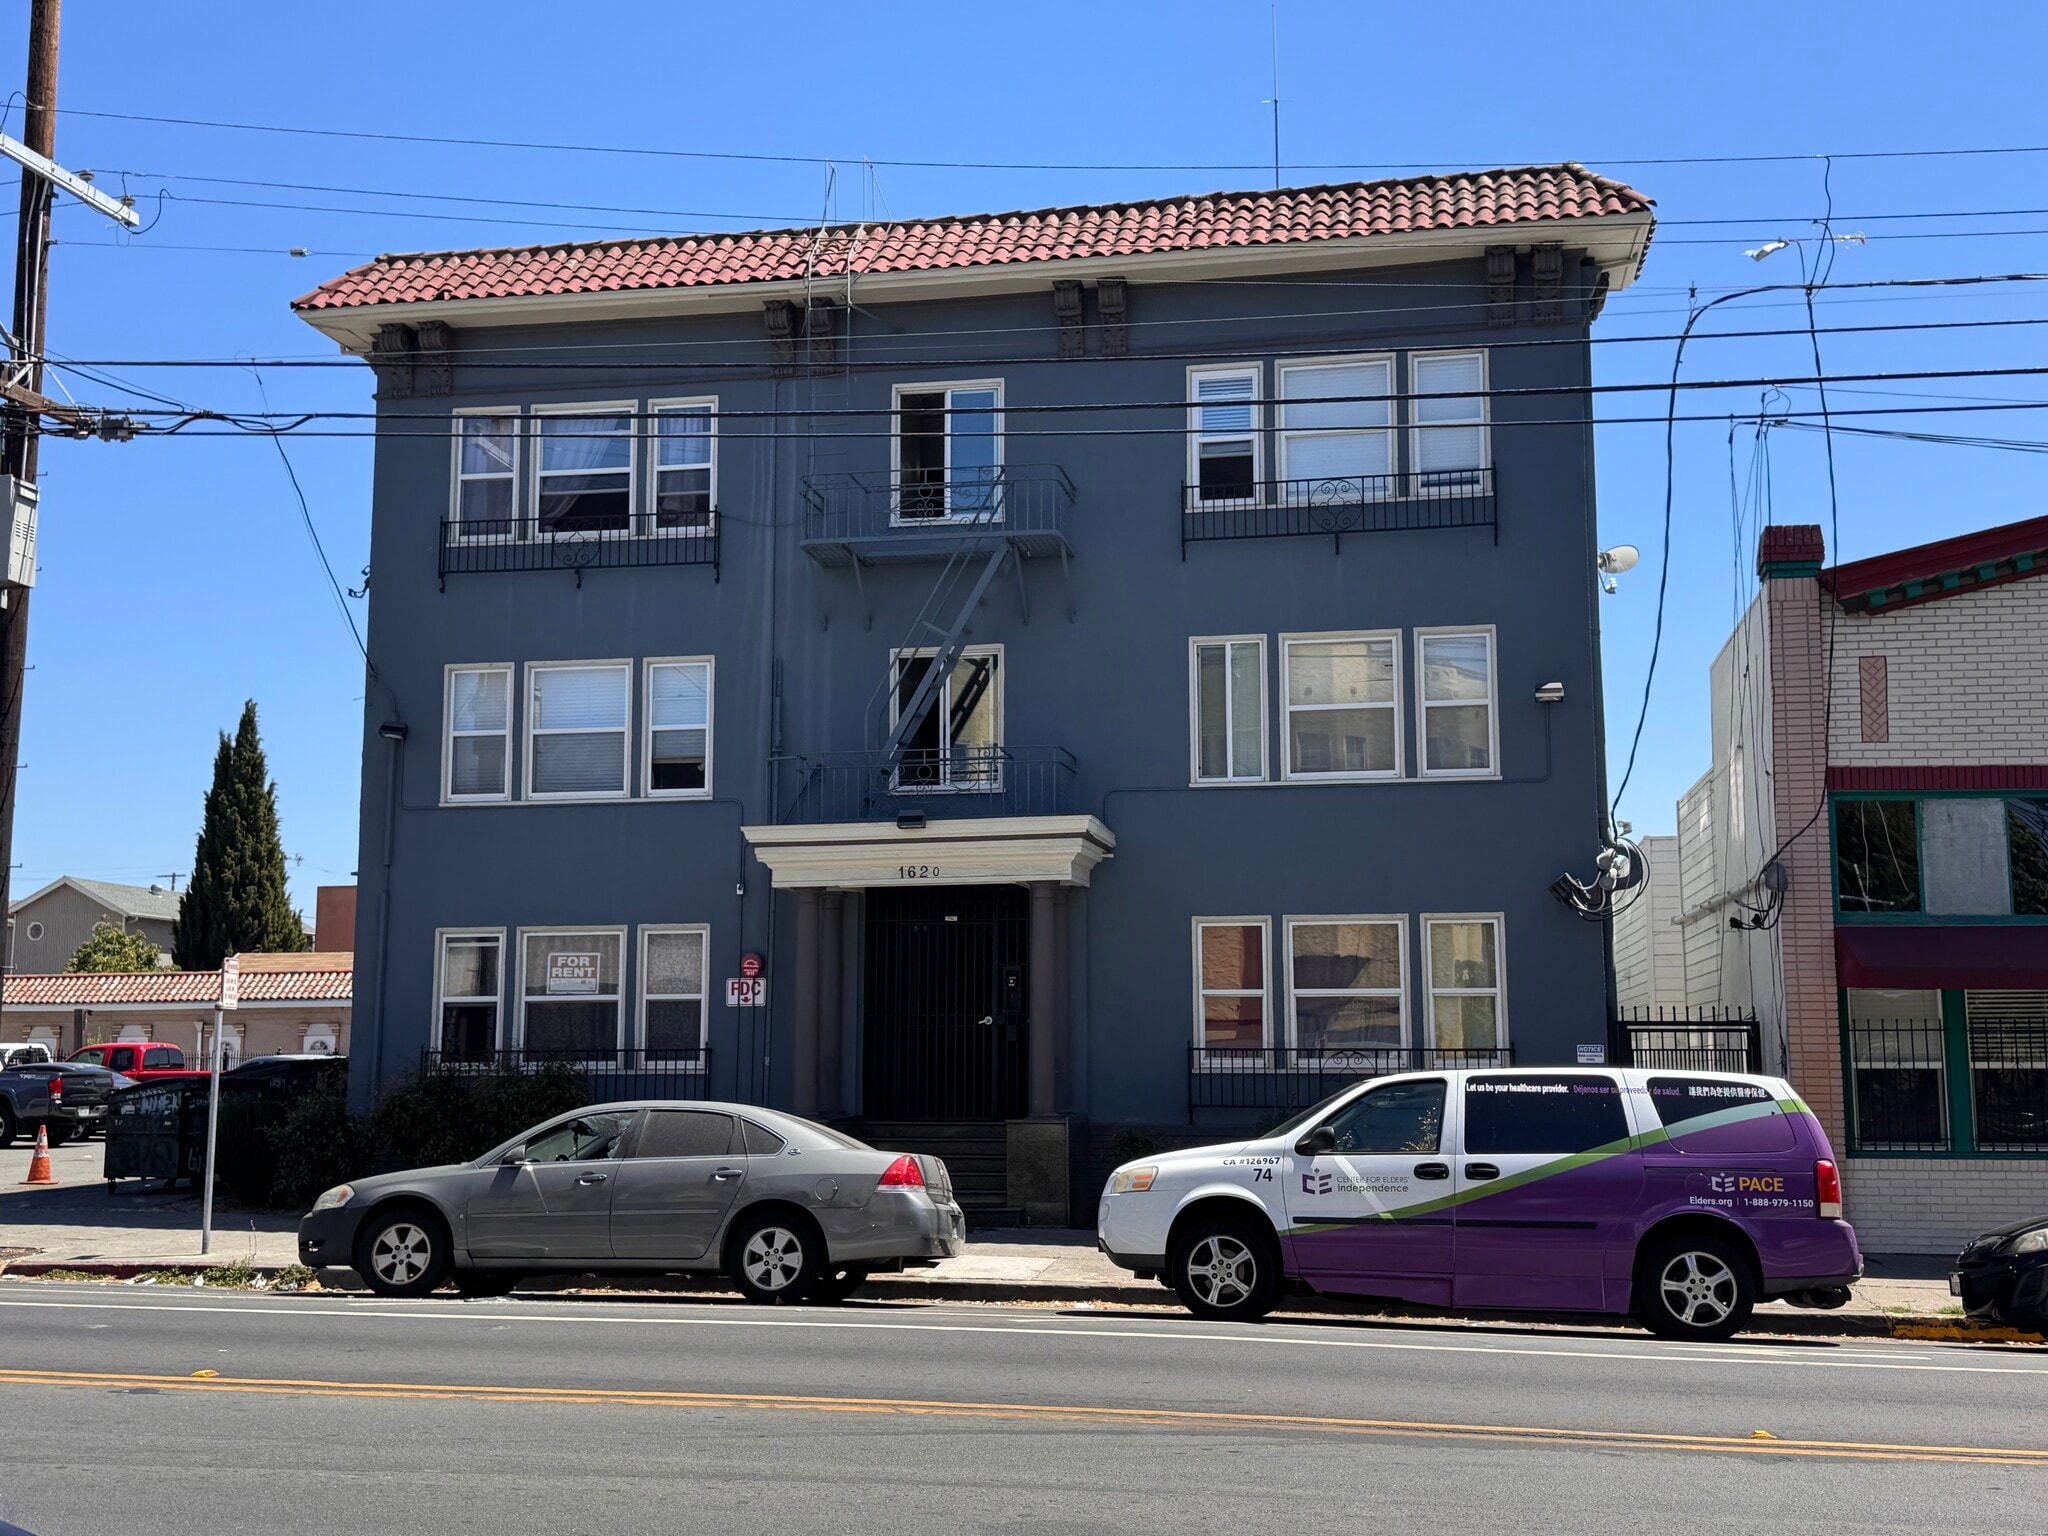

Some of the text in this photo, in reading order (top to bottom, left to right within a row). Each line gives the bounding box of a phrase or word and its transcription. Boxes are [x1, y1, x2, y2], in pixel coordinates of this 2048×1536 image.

[899, 865, 940, 879] 1620
[557, 956, 590, 967] FOR
[552, 967, 595, 977] RENT
[731, 981, 761, 996] FDC
[1466, 1083, 1476, 1092] Let
[1486, 1083, 1494, 1092] be
[1495, 1085, 1508, 1094] your
[1509, 1083, 1541, 1093] healthcare
[1542, 1083, 1569, 1095] provider.
[1653, 1086, 1661, 1095] de
[1223, 1157, 1280, 1166] CA #126967
[1253, 1168, 1273, 1182] 74
[1336, 1176, 1364, 1184] CENTER
[1366, 1176, 1381, 1184] FOR
[1337, 1183, 1409, 1194] independence
[1739, 1177, 1784, 1192] PACE
[1689, 1196, 1814, 1208] Elders.org 1-888-979-1150
